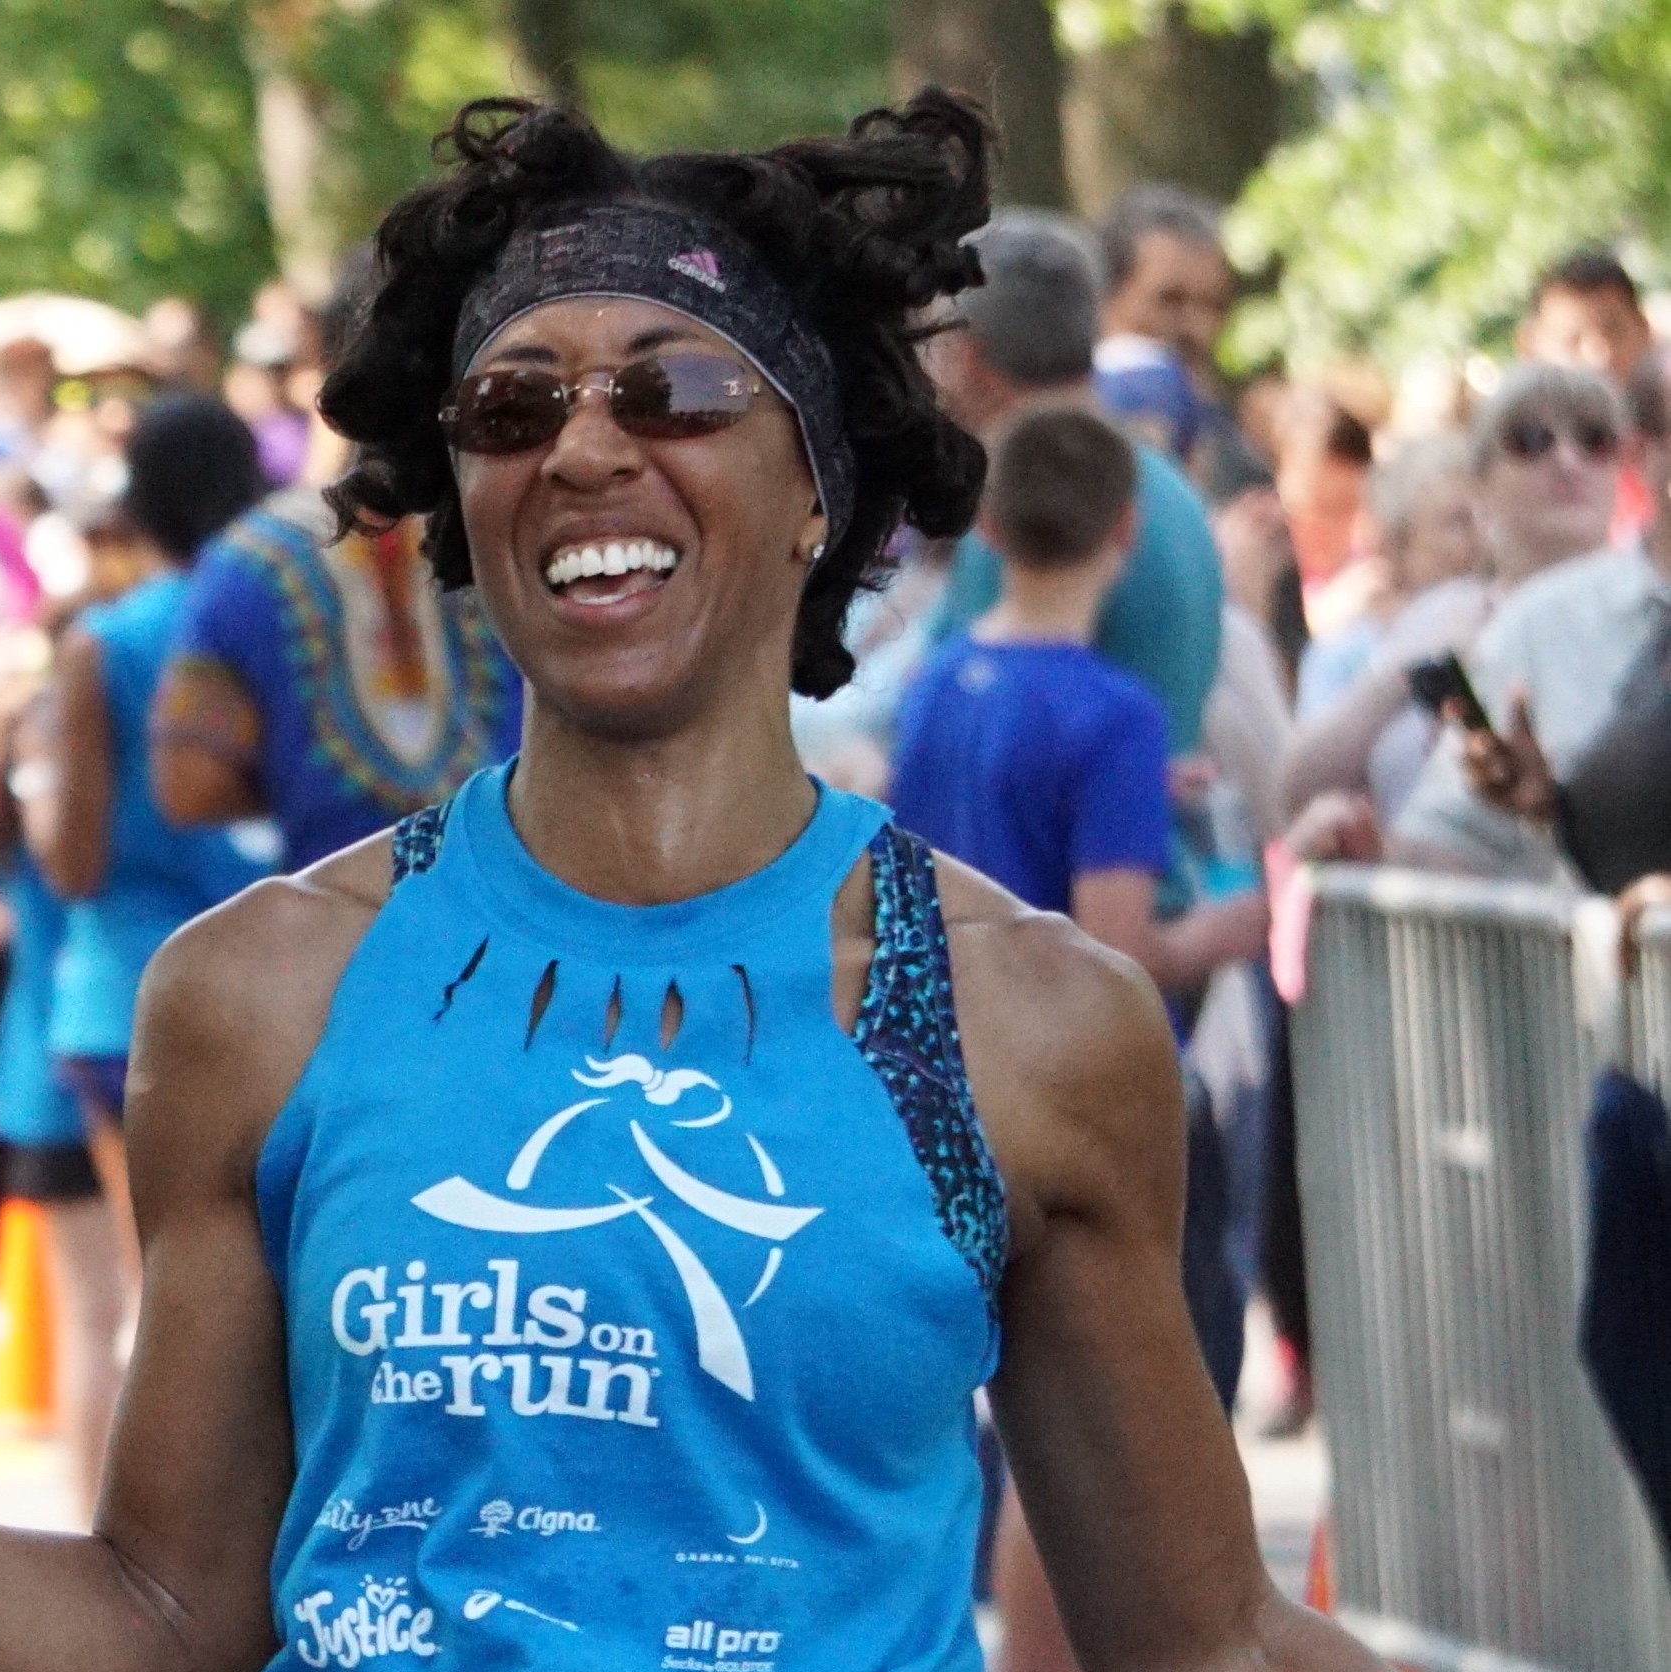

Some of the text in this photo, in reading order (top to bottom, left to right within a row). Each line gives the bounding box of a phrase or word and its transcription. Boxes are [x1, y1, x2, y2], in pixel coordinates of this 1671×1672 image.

[331, 1259, 657, 1358] Girls on
[441, 1355, 659, 1428] run
[517, 1506, 596, 1536] Cigna
[294, 1588, 436, 1669] Justice
[665, 1620, 779, 1659] all pro
